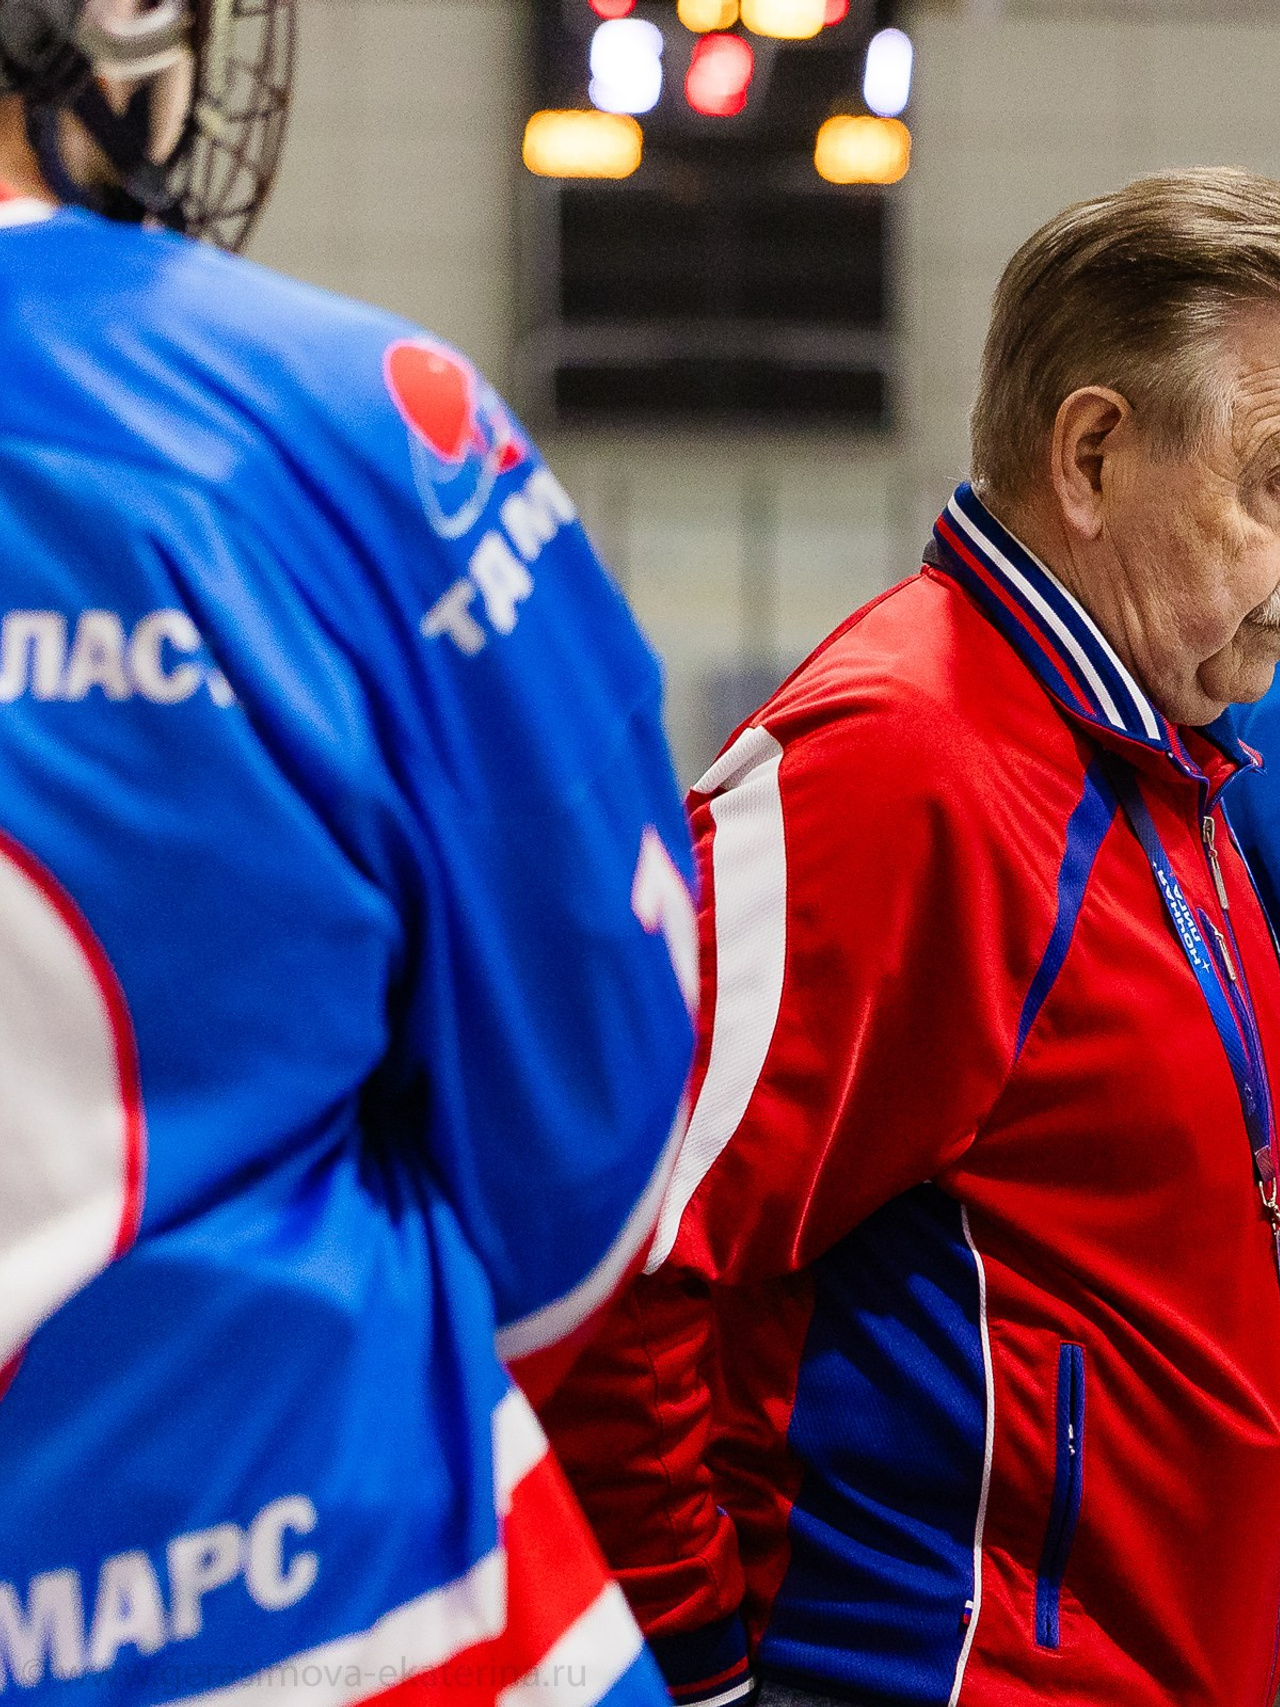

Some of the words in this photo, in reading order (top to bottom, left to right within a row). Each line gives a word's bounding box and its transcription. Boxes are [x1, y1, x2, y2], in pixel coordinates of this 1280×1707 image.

[1158, 869, 1201, 965] НОЧНАЯ
[1173, 884, 1202, 942] ЛИГА
[0, 1495, 318, 1693] МАРС
